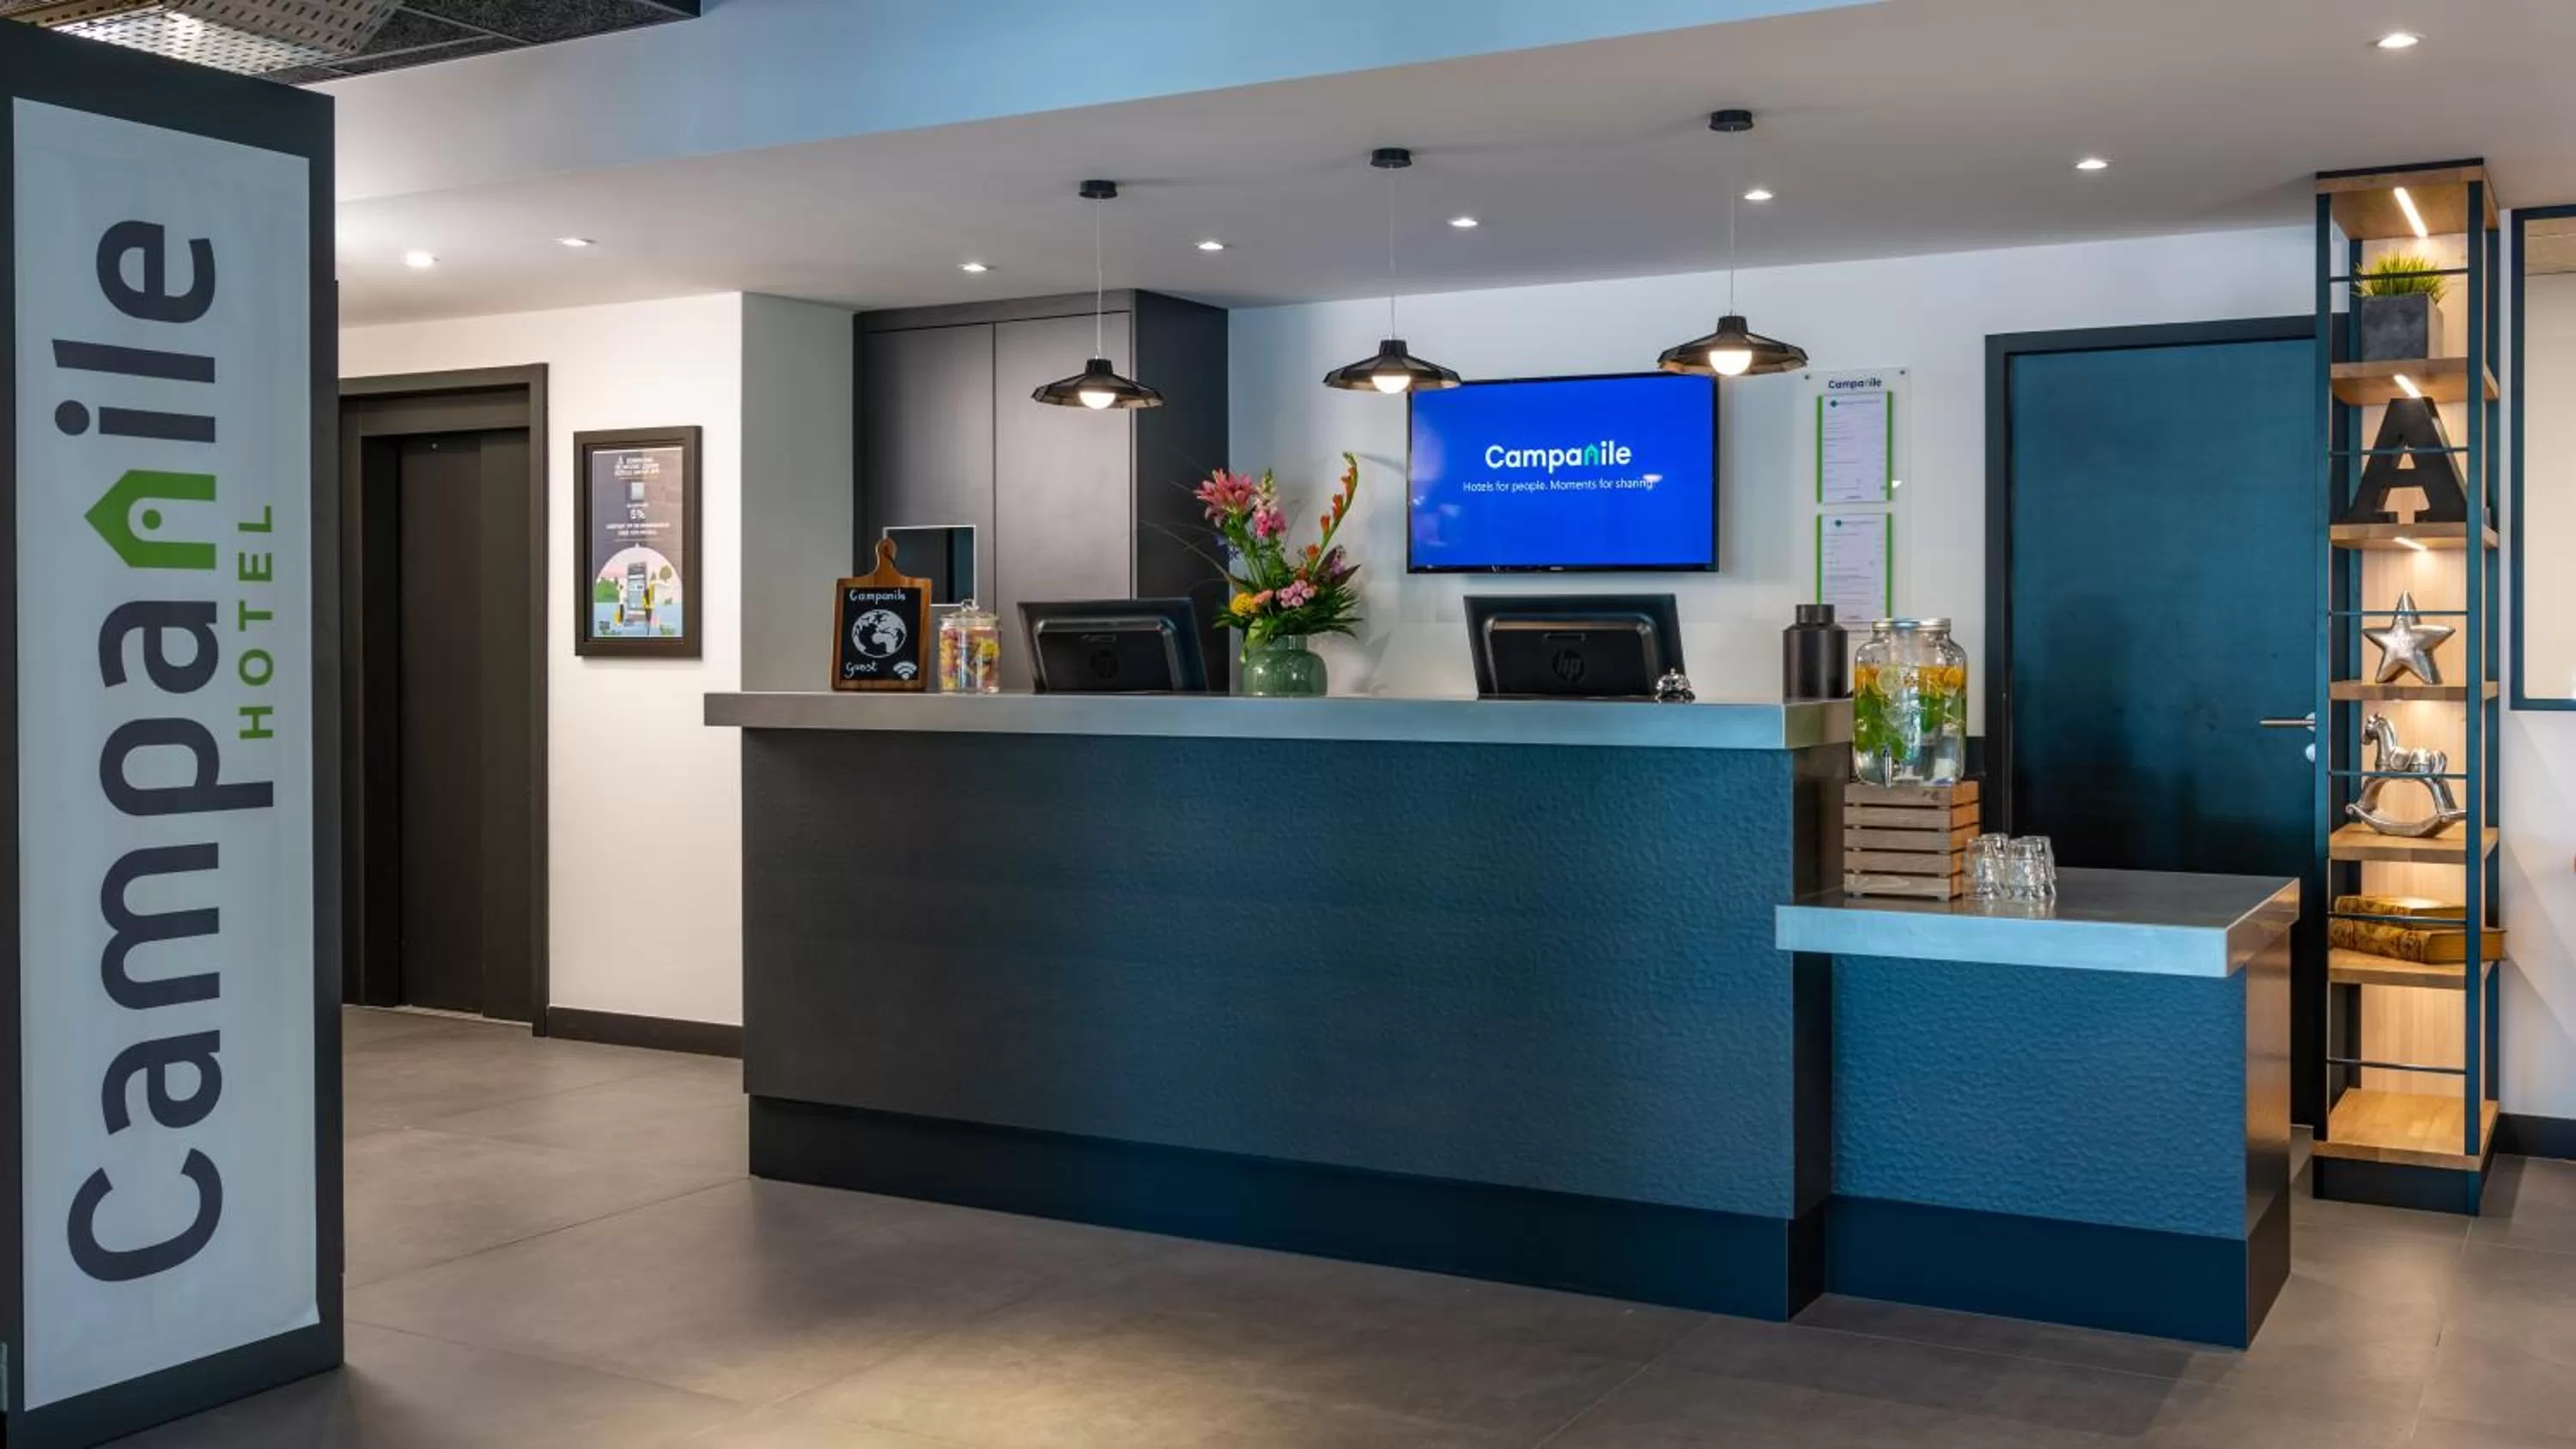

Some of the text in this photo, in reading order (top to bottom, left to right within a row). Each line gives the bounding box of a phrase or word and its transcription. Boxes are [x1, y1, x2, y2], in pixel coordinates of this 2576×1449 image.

[1462, 481, 1494, 493] Hotels
[1495, 480, 1509, 492] for
[1510, 480, 1548, 494] people.
[1550, 478, 1596, 491] Moments
[1599, 477, 1613, 489] for
[1485, 440, 1632, 474] Campanile
[2340, 397, 2468, 524] A
[237, 504, 275, 740] HOTEL
[849, 589, 907, 604] Campanile
[52, 220, 273, 1282] Campanile
